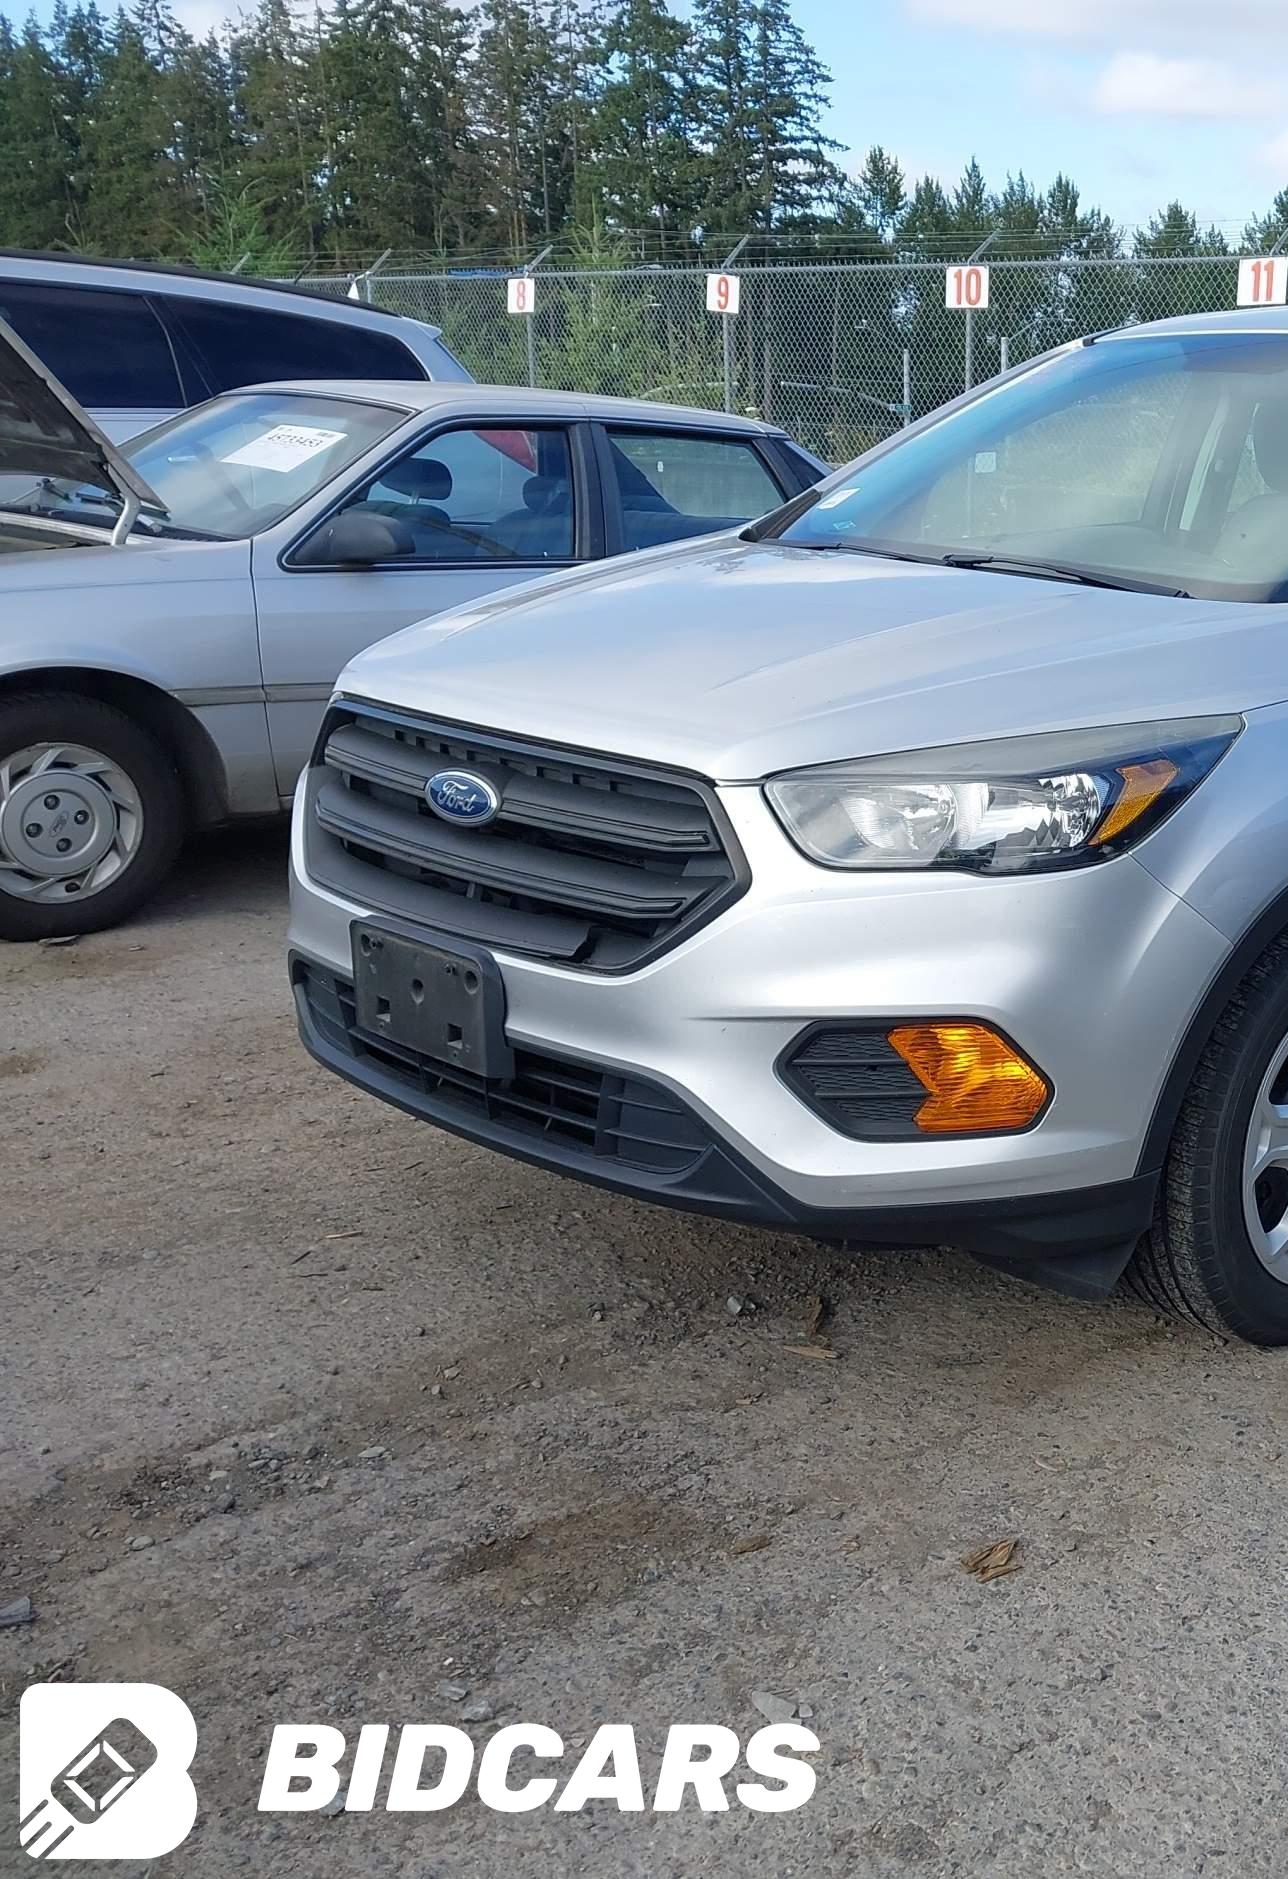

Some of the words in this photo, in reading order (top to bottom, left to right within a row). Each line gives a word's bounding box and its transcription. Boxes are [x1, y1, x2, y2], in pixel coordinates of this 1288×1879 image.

[516, 279, 526, 311] 8
[717, 276, 728, 310] 9
[953, 268, 982, 306] 10
[1251, 260, 1274, 302] 11
[437, 780, 477, 812] Ford
